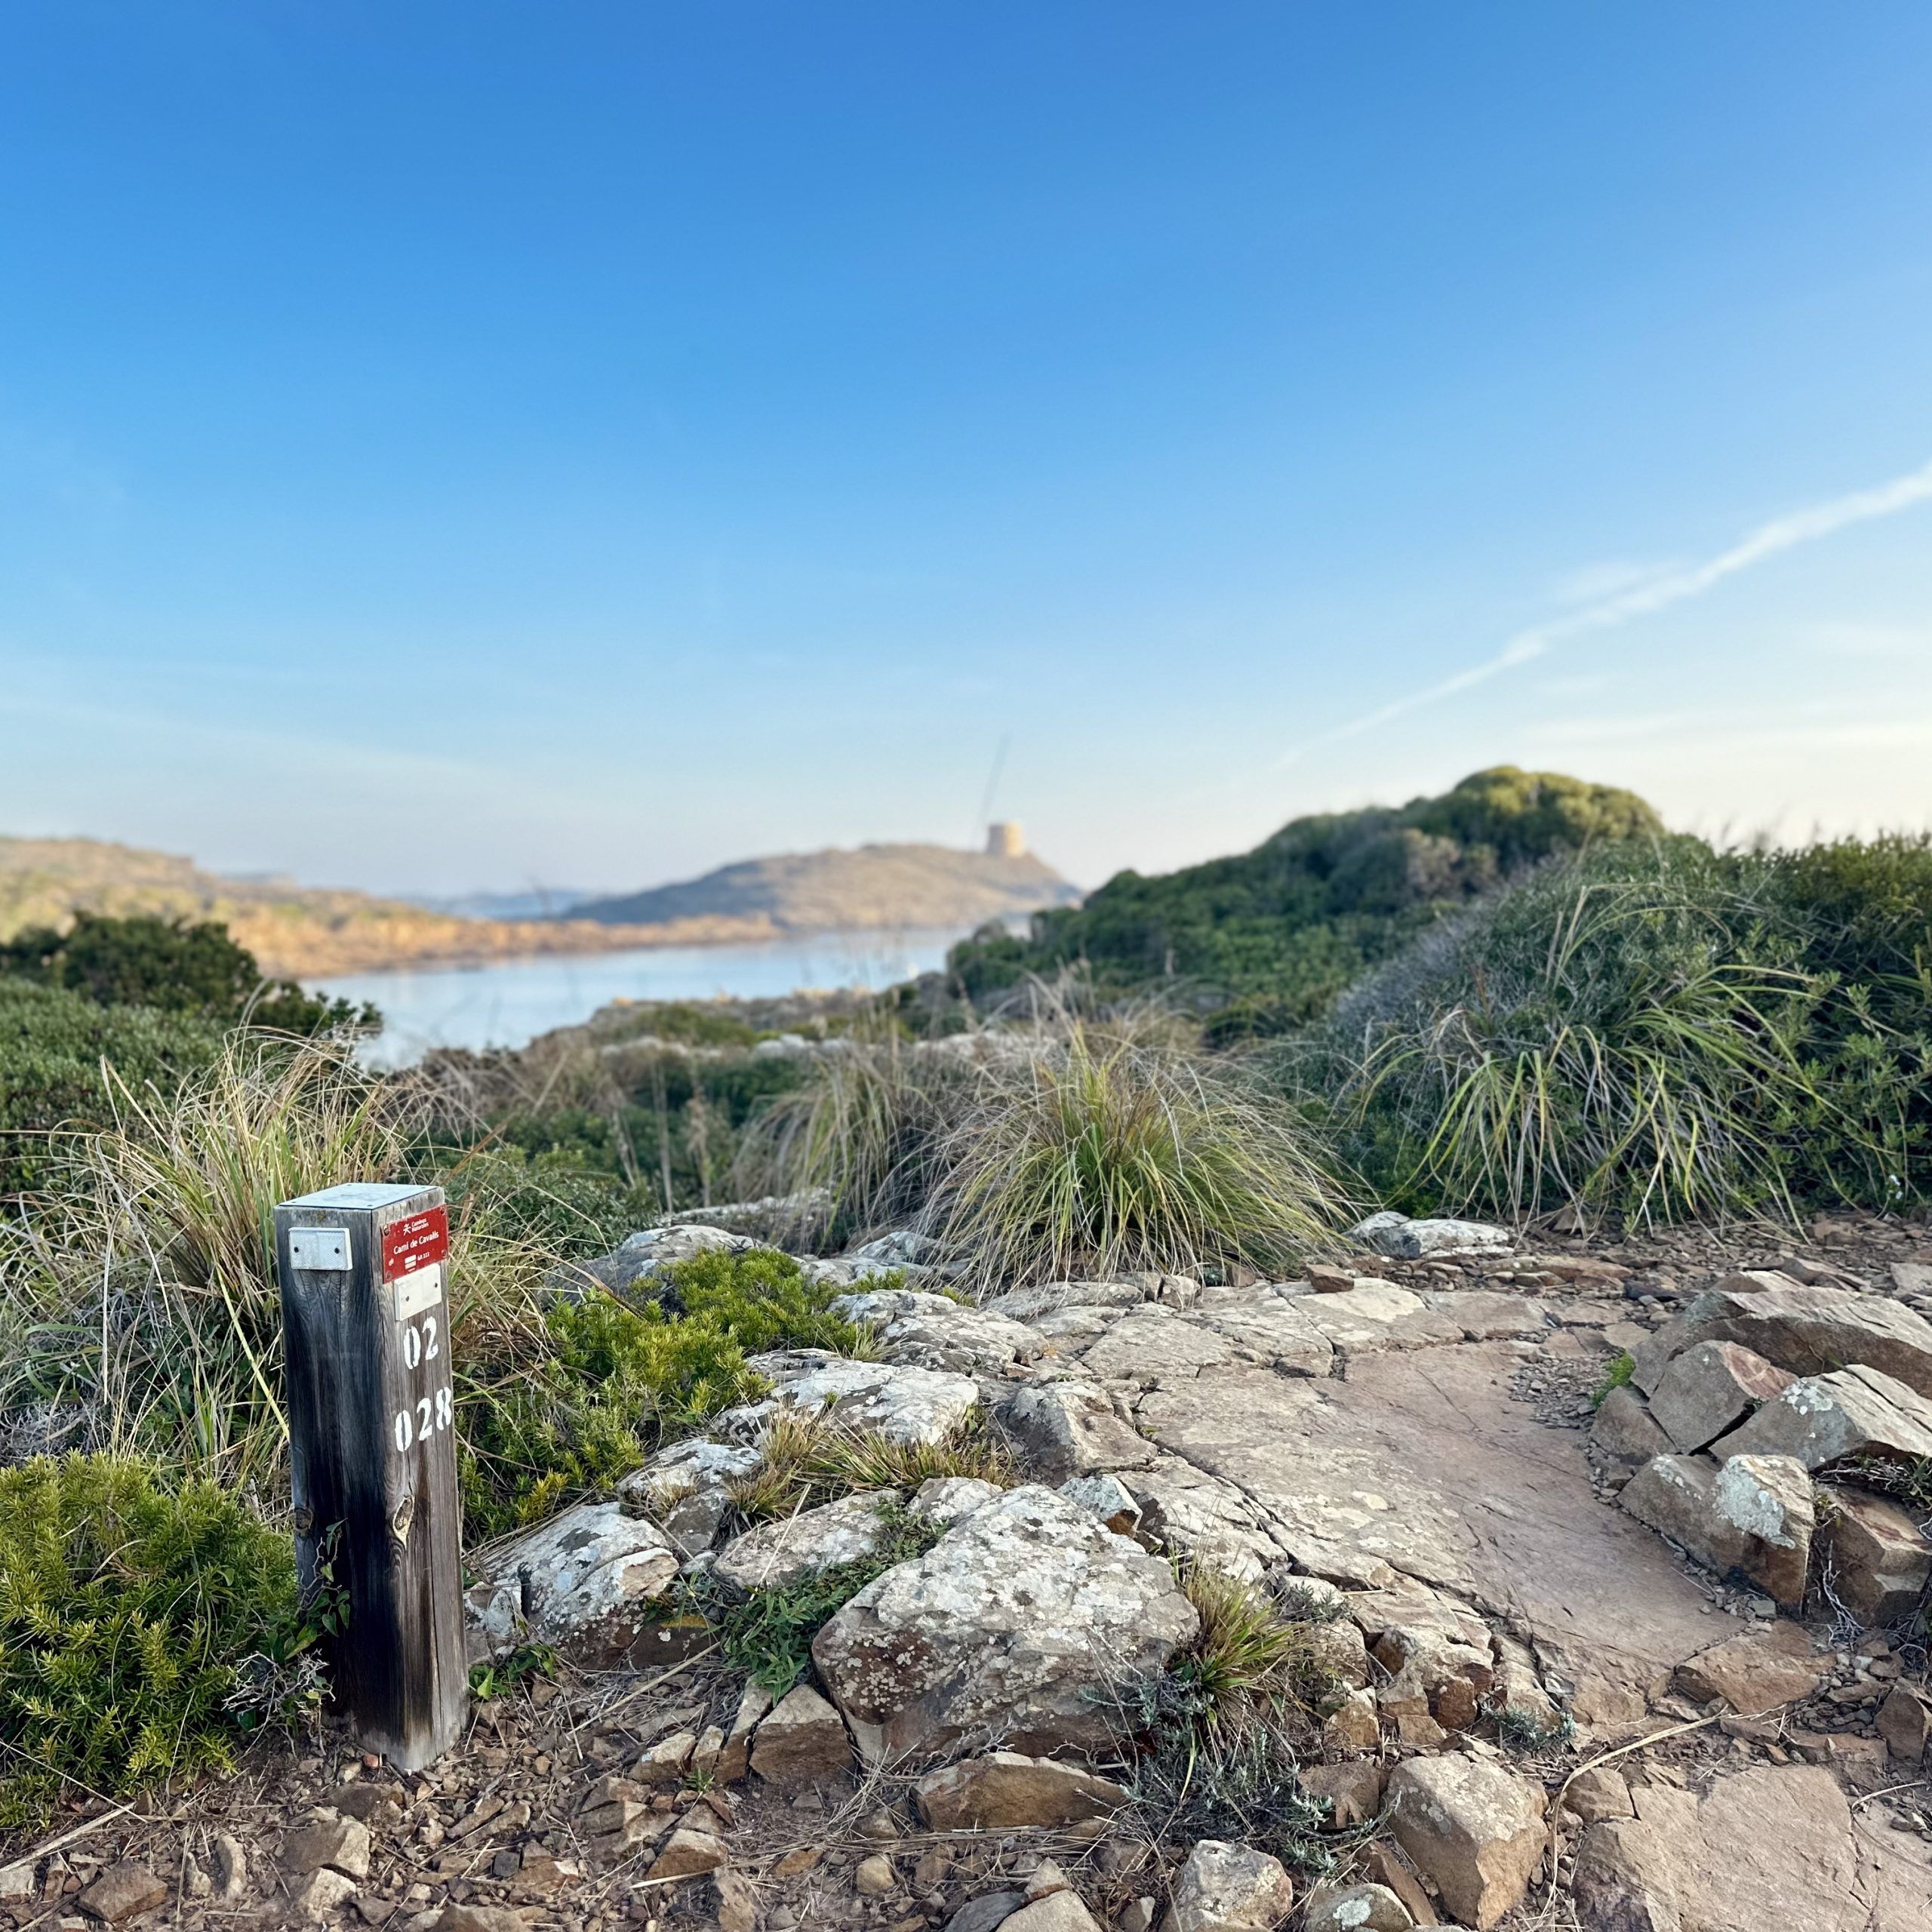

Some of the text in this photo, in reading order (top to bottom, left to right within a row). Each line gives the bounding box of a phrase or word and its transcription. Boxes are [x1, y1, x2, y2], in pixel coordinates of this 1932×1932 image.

[410, 1238, 418, 1248] de
[419, 1230, 439, 1244] Cavalls
[404, 1316, 438, 1370] 02
[395, 1387, 452, 1452] 028
